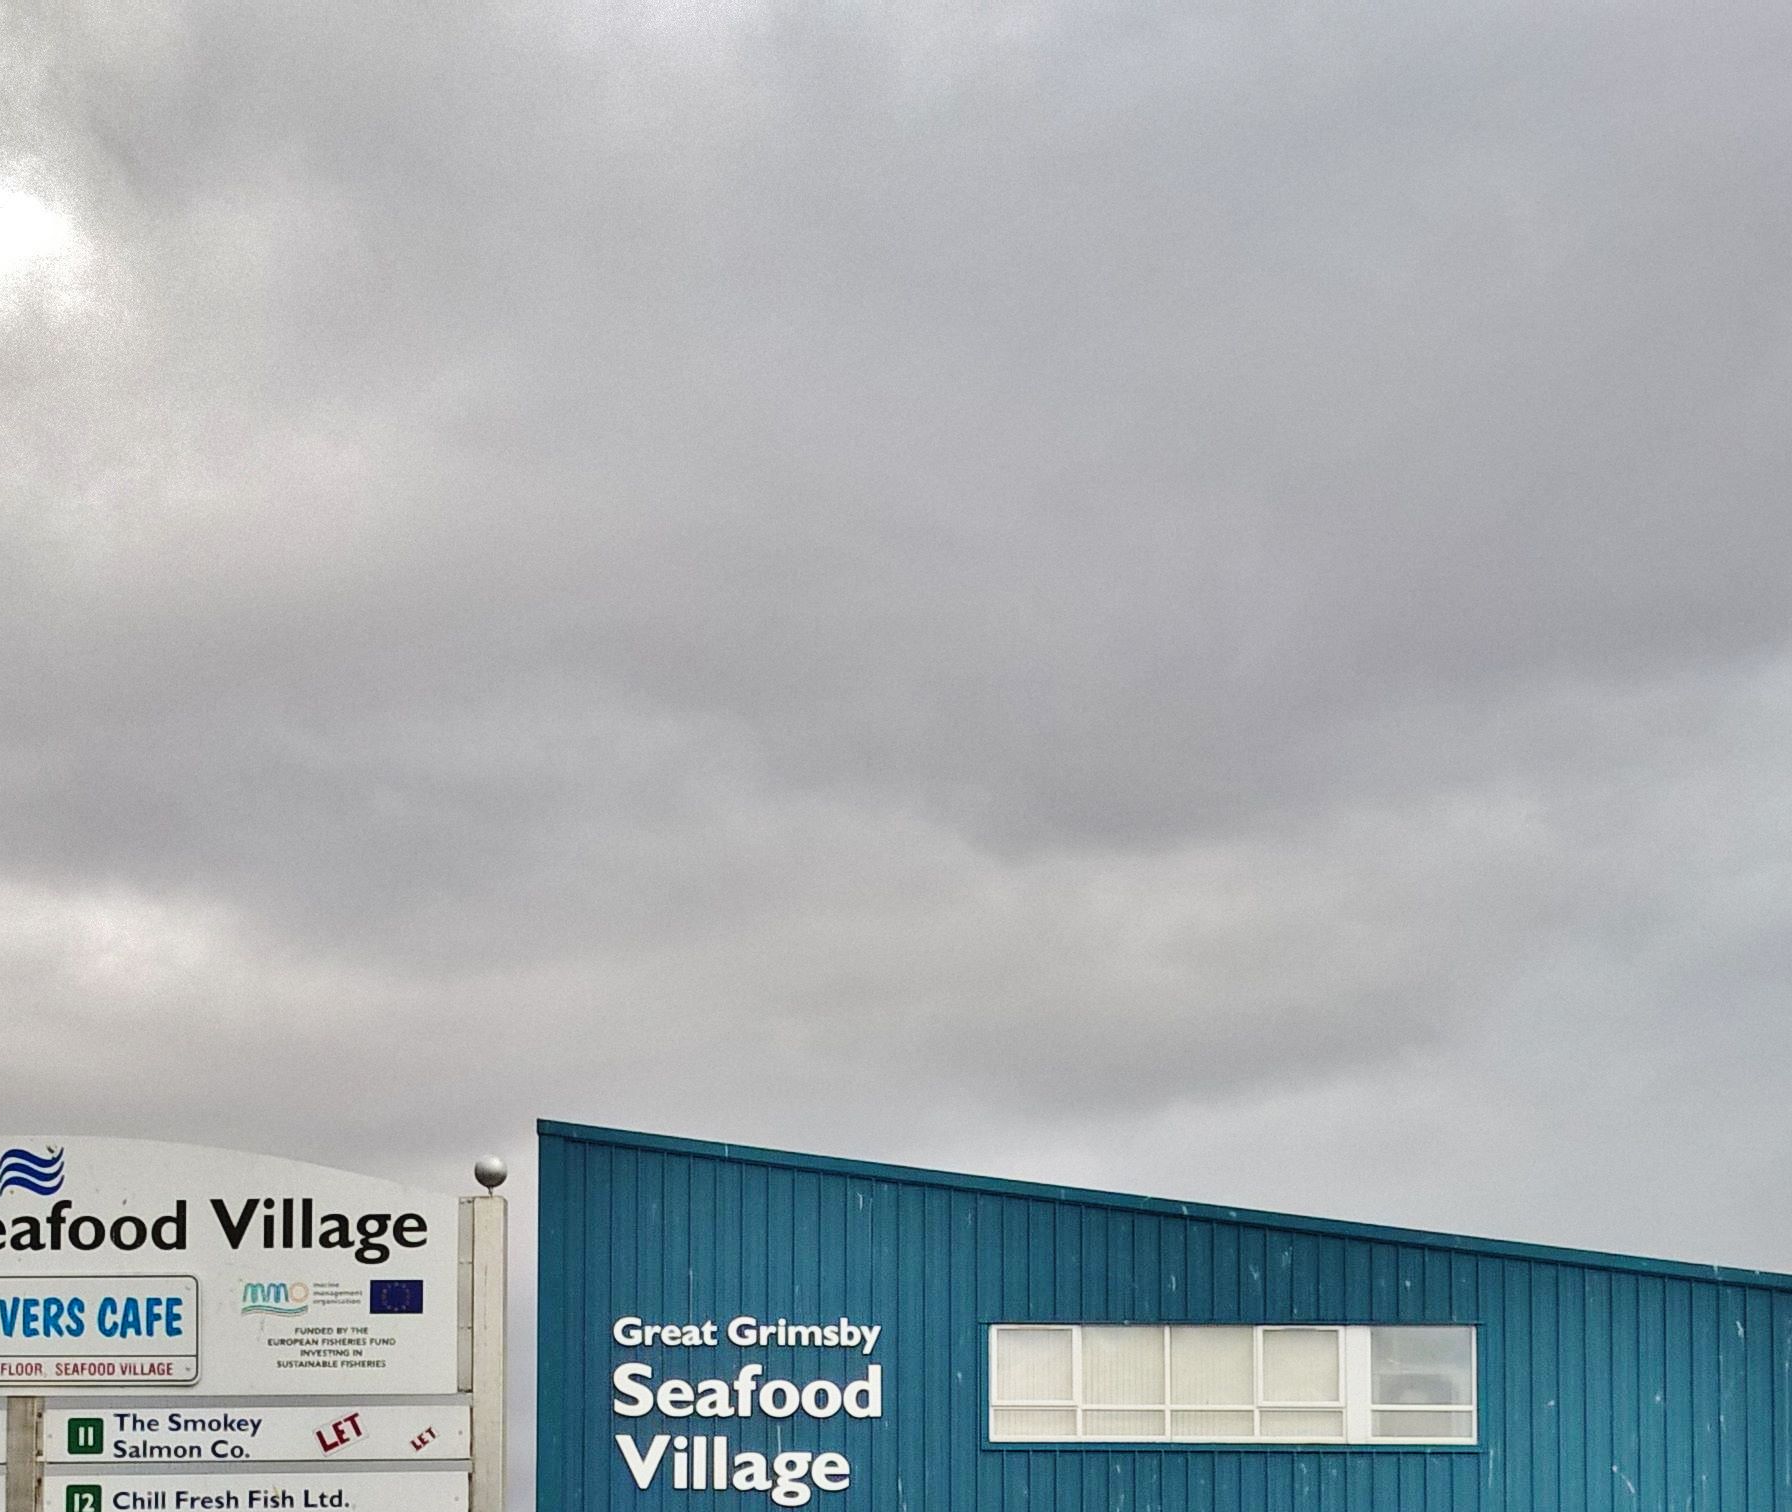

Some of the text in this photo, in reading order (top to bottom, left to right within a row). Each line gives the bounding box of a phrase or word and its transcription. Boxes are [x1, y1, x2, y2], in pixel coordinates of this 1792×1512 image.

[211, 1198, 428, 1263] Village
[98, 1297, 183, 1338] CAFE
[614, 1317, 881, 1355] Great Grimsby
[56, 1363, 115, 1376] SEAFOOD
[121, 1363, 173, 1375] VILLAGE
[613, 1363, 882, 1418] Seafood
[114, 1414, 160, 1432] The
[168, 1413, 262, 1437] Smokey
[315, 1413, 363, 1452] LET
[410, 1426, 435, 1451] LET
[113, 1440, 250, 1459] Salmon Co.
[615, 1435, 850, 1506] Village
[73, 1489, 349, 1512] 12 Chill Fresh Fish Ltd.
